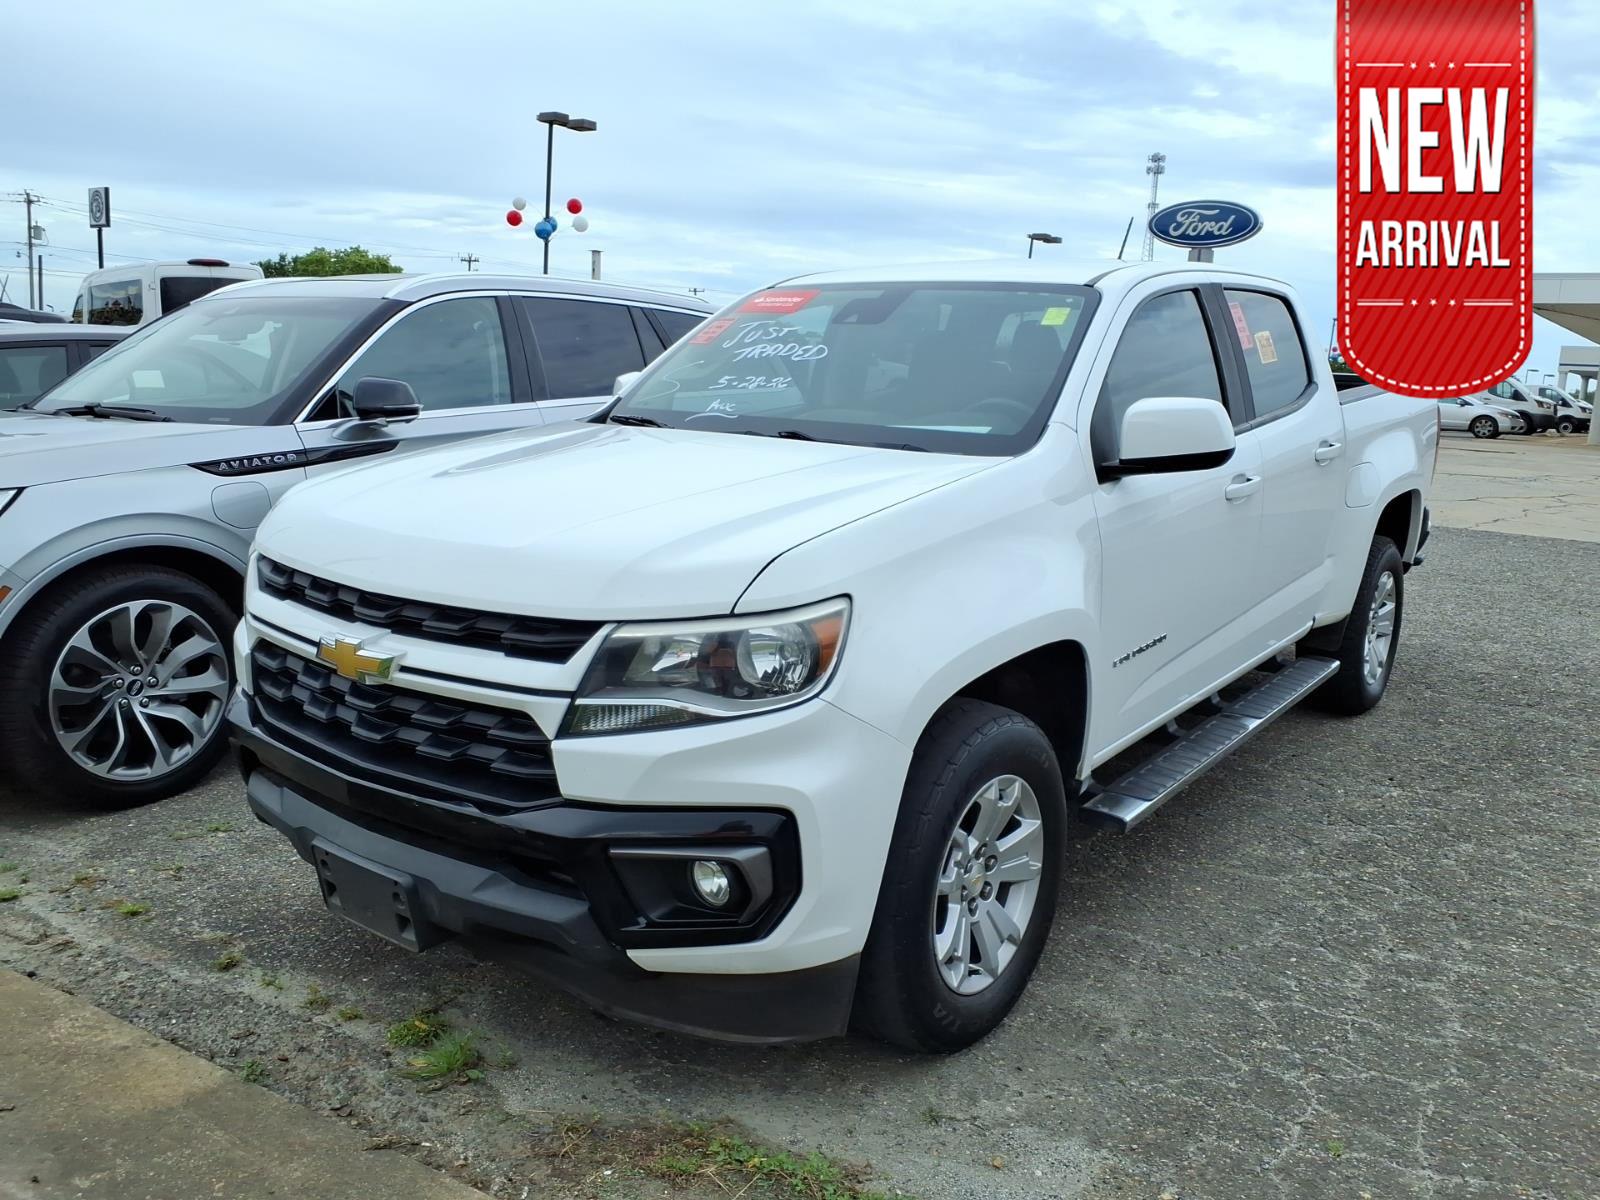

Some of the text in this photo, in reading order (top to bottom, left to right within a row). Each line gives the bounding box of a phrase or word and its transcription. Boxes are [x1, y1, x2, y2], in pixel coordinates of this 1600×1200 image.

[1168, 208, 1236, 237] Ford
[732, 343, 828, 361] TRADED
[218, 453, 297, 471] AVIATOR
